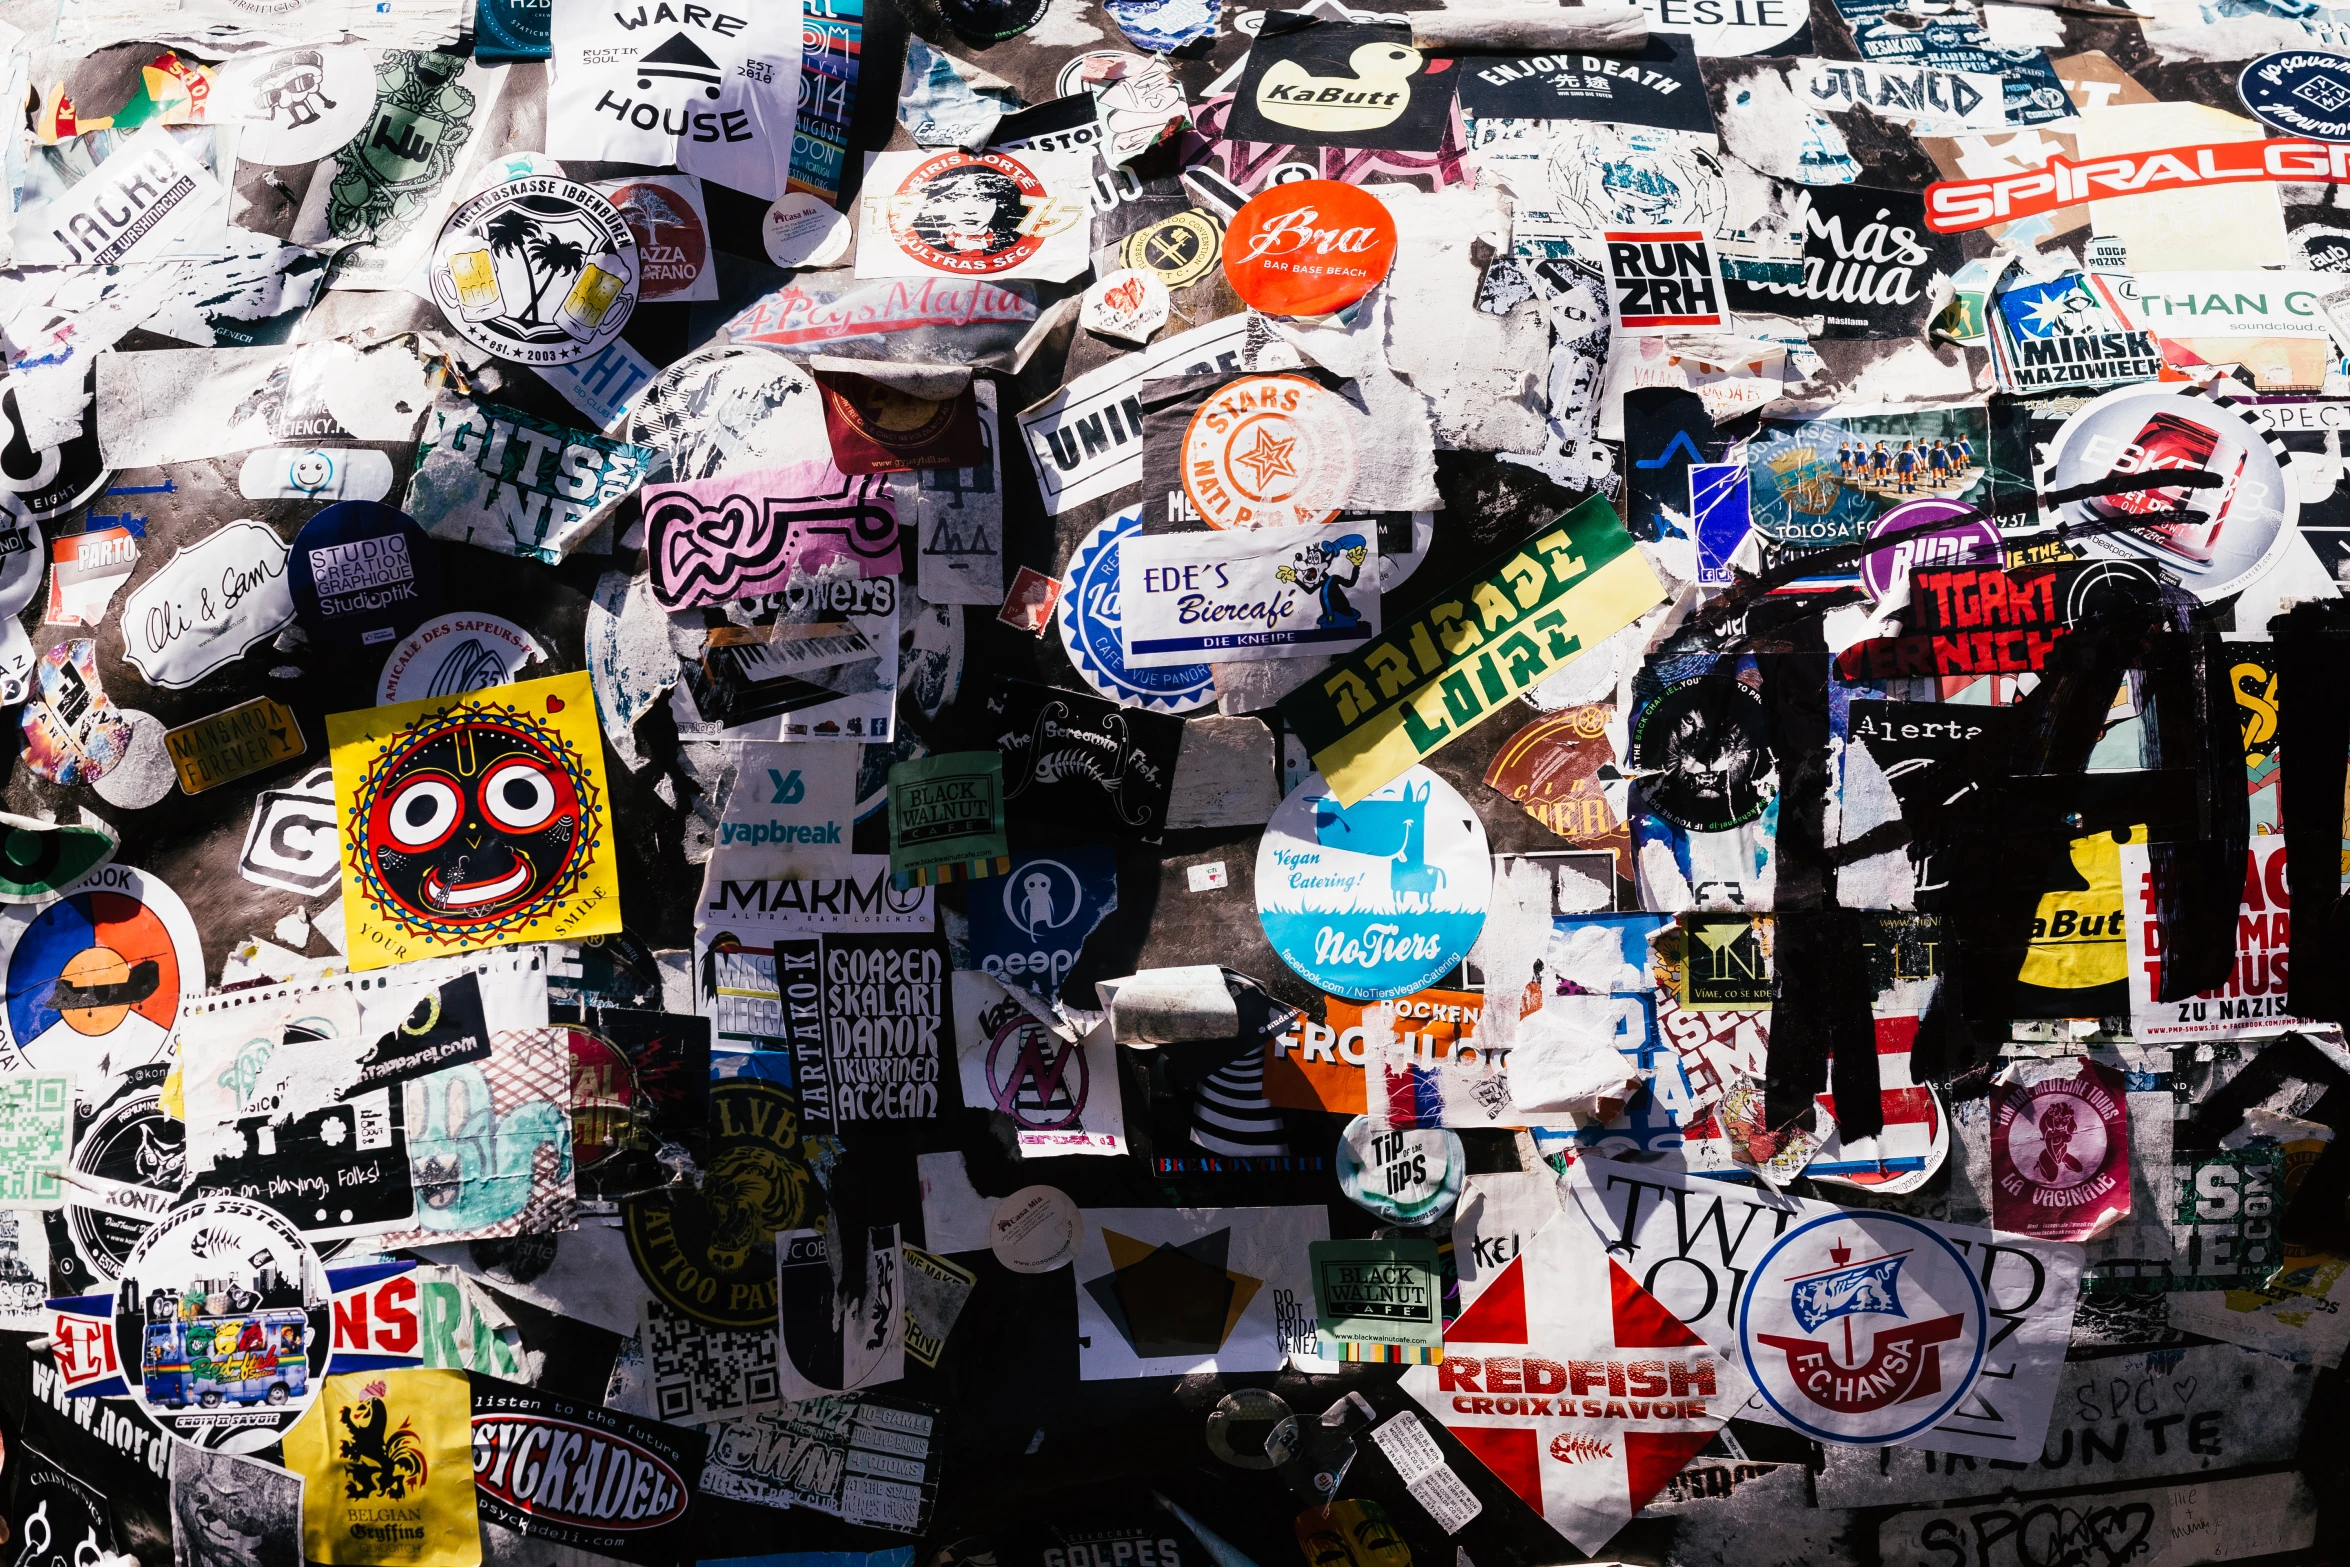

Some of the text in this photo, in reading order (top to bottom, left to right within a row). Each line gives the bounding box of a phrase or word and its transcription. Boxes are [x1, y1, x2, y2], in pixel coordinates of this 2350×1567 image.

[613, 1, 749, 40] WARE
[582, 46, 639, 58] RUSTIK
[582, 55, 620, 66] SOUL
[736, 66, 774, 86] 2010
[1476, 54, 1683, 97] ENJOY DEATH
[1265, 83, 1401, 108] KaButt
[594, 88, 754, 145] HOUSE
[907, 150, 1038, 192] BIRIS NORTE
[117, 175, 196, 255] WASHMACHINE
[452, 179, 635, 251] URLAUBSKASSE IBBENBÜREN
[1235, 204, 1380, 265] Bra
[908, 239, 1033, 271] ULTRAS SFC
[1263, 260, 1368, 279] BAR BASE BEACH
[1608, 242, 1711, 278] RUN
[1613, 278, 1719, 316] ZRH
[215, 326, 255, 344] GENECH
[2021, 328, 2160, 368] MINSK
[526, 349, 557, 362] 2003
[1204, 385, 1302, 437] STARS
[33, 484, 78, 509] EIGHT
[1775, 522, 1848, 540] TOLOSA
[310, 535, 407, 570] STUDIO
[2027, 540, 2061, 562] THE
[313, 553, 411, 584] CREATION
[316, 565, 413, 596] GRAPHIQUE
[200, 587, 217, 623] &
[1176, 590, 1296, 630] Biercafé
[422, 623, 452, 644] DES
[1203, 632, 1297, 649] DIE KNEIPE
[1402, 608, 1583, 756] LOIRE
[171, 701, 284, 760] MANSARDA
[1635, 716, 1648, 742] BACK
[184, 735, 274, 787] FOREVER
[997, 730, 1032, 752] The
[1127, 747, 1157, 782] Fish
[909, 781, 978, 808] BLACK
[901, 799, 988, 828] WALNUT
[720, 821, 842, 847] yapbreak
[903, 848, 993, 869] www.blackwalnutcafe.com
[1273, 850, 1321, 872] Vegan
[1288, 871, 1366, 893] Catering!
[359, 886, 607, 960] YOUR SMILE
[807, 914, 838, 924] SAN
[853, 915, 926, 925] LORENZO
[1314, 921, 1443, 970] NoTiers
[1281, 947, 1461, 1000] facebook.com NoTiersVeganCatering
[828, 983, 943, 1019] SKALARI
[2178, 996, 2287, 1023] ZU NAZIS
[829, 1014, 943, 1059] DANOK
[2147, 1024, 2220, 1037] WWW.PMP-SHOWS.DE
[2034, 1076, 2090, 1098] MEDECINE
[2086, 1084, 2120, 1122] TOURS
[239, 1160, 380, 1201] on playing, Folks!
[2000, 1171, 2117, 1208] LA VAGINALE
[1009, 1195, 1044, 1226] Casa Mia
[643, 1204, 719, 1305] ATTOO
[1338, 1266, 1415, 1285] BLACK
[1273, 1288, 1294, 1306] DO
[1330, 1285, 1426, 1304] WALNUT
[1275, 1303, 1303, 1321] NOT
[1333, 1332, 1428, 1345] www.blackwalnutcafe.com
[1438, 1354, 1718, 1398] REDFISH
[1451, 1395, 1550, 1418] CROIX
[1581, 1399, 1708, 1420] SAVOIE
[473, 1396, 680, 1462] listen to the future
[346, 1508, 422, 1524] BELGIAN
